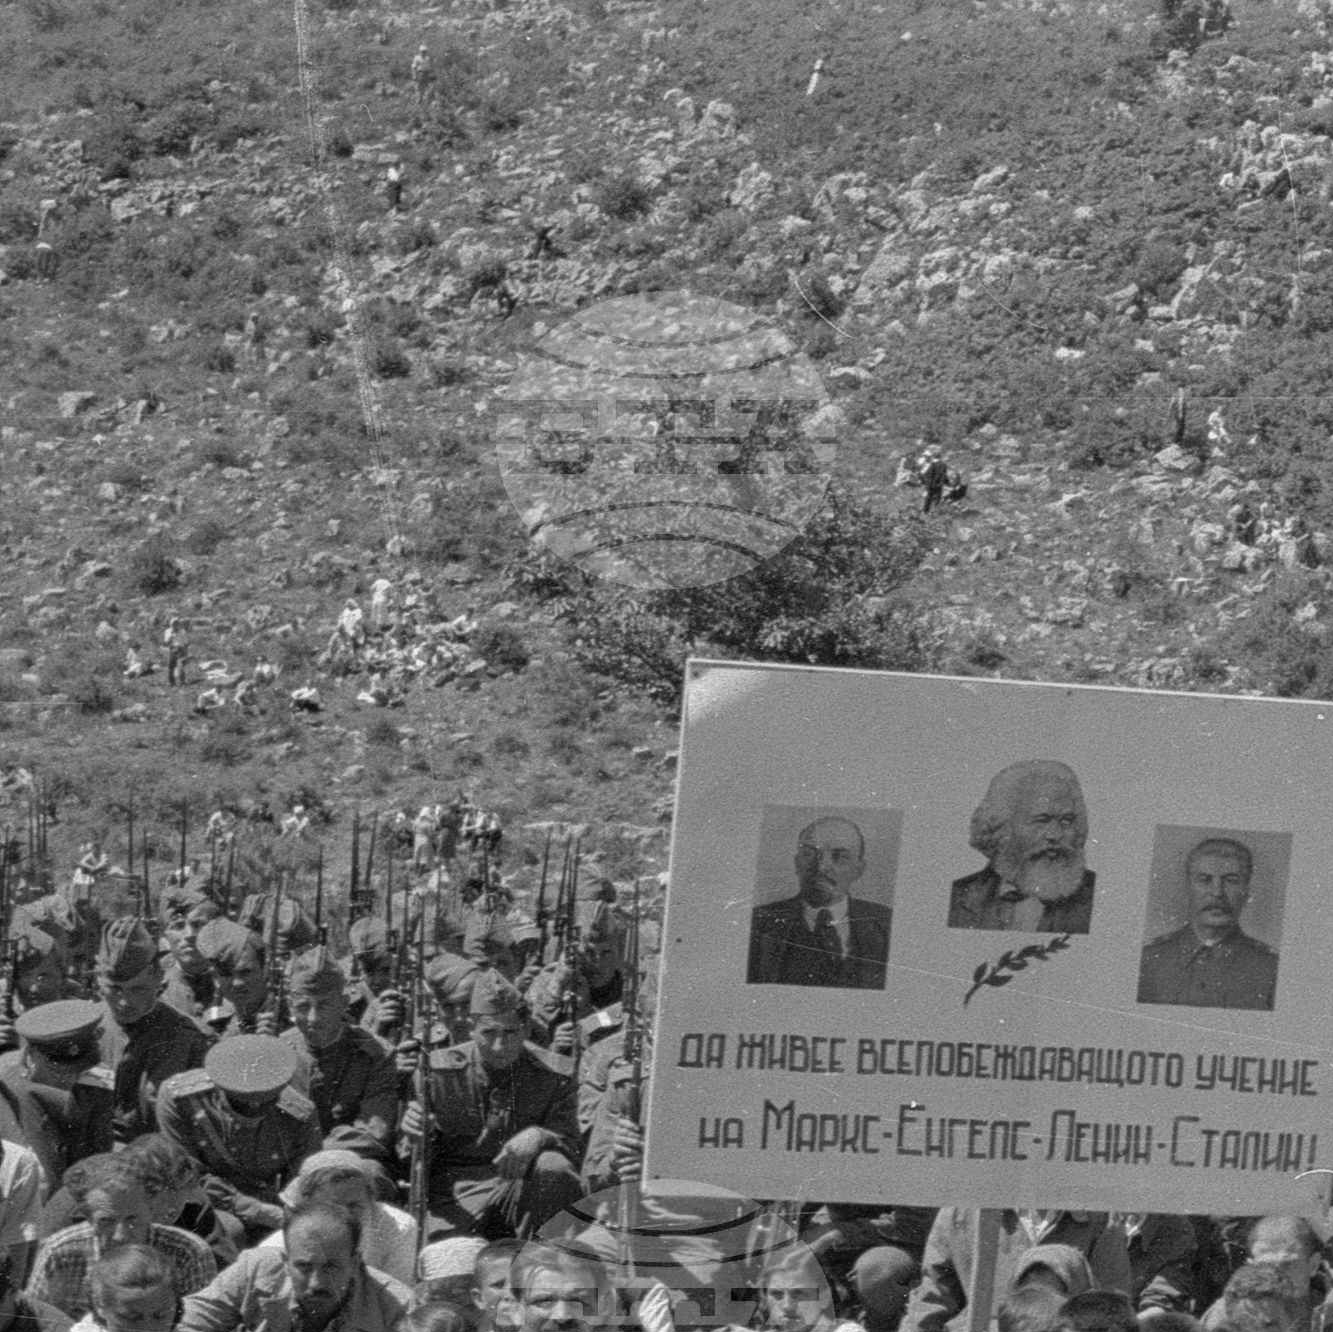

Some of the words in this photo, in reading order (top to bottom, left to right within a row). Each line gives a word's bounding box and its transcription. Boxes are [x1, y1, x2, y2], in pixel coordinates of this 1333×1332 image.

[676, 1032, 727, 1069] ДА
[736, 1033, 847, 1074] ЖИВЕЕ
[857, 1038, 1179, 1086] ВСЕПОБЕЖДАВАЩОТО
[1195, 1054, 1319, 1097] УЧЕНИЕ
